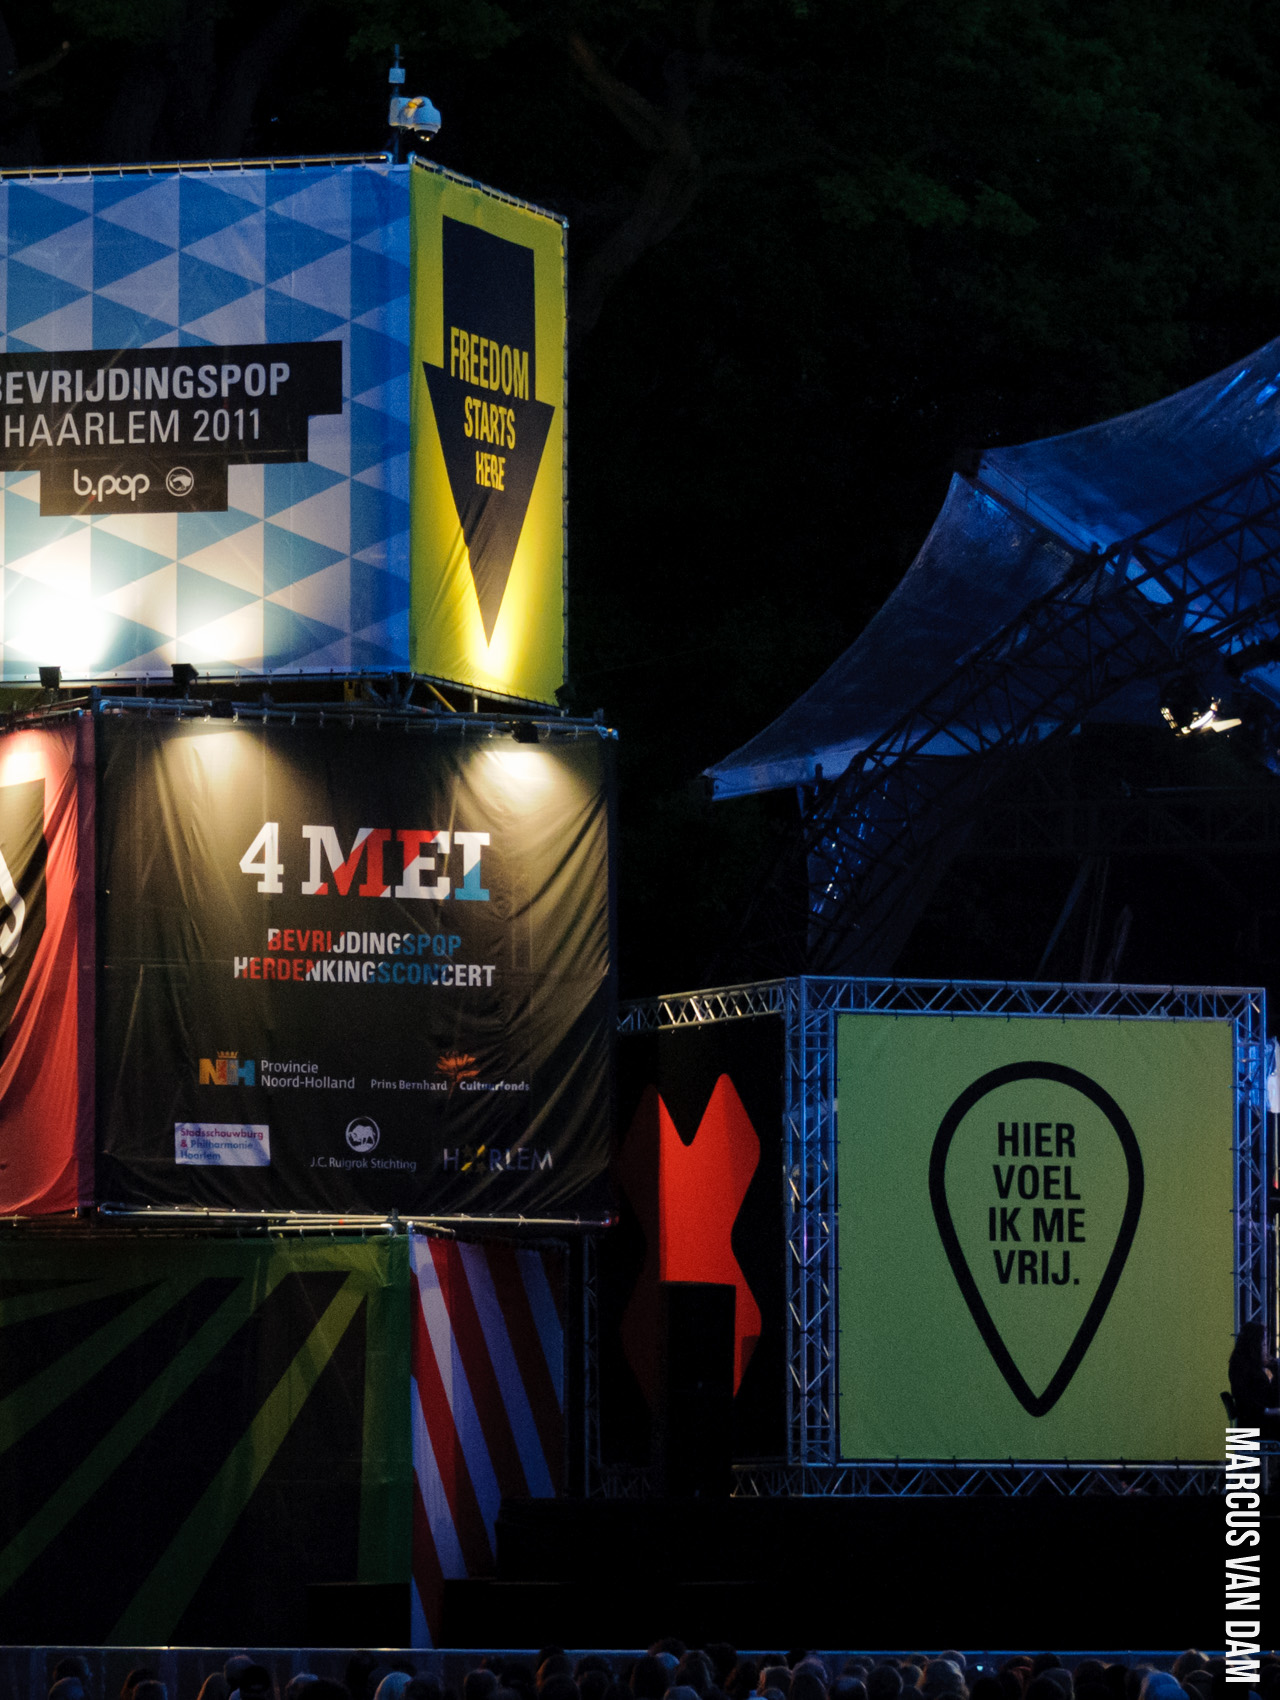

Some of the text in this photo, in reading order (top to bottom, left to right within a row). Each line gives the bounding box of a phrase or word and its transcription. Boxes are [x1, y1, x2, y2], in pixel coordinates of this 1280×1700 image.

[450, 326, 529, 401] FREEDOM
[3, 408, 261, 448] HAARLEM 2011
[464, 395, 516, 450] STARTS
[73, 468, 151, 502] b.pop
[475, 450, 506, 492] HERE
[238, 821, 491, 902] 4 MEI
[267, 928, 462, 957] BEVRIJDINGSPOP
[233, 956, 496, 987] HERDENKINGSCONCERT
[260, 1059, 319, 1075] Provincie
[260, 1074, 356, 1090] Noord-Holland
[370, 1078, 531, 1092] Prins Bernhard Cultuurfonds
[180, 1127, 264, 1141] Stadsschouwburg
[191, 1138, 254, 1150] Philharmonie
[997, 1121, 1076, 1158] HIER
[180, 1149, 221, 1160] Haarlem
[329, 1157, 369, 1171] Ruigrok
[370, 1157, 417, 1173] Stichting
[442, 1144, 554, 1173] HRLEM
[992, 1164, 1082, 1201] VOEL
[988, 1207, 1086, 1244] IK ME
[992, 1249, 1080, 1286] VRIJ.
